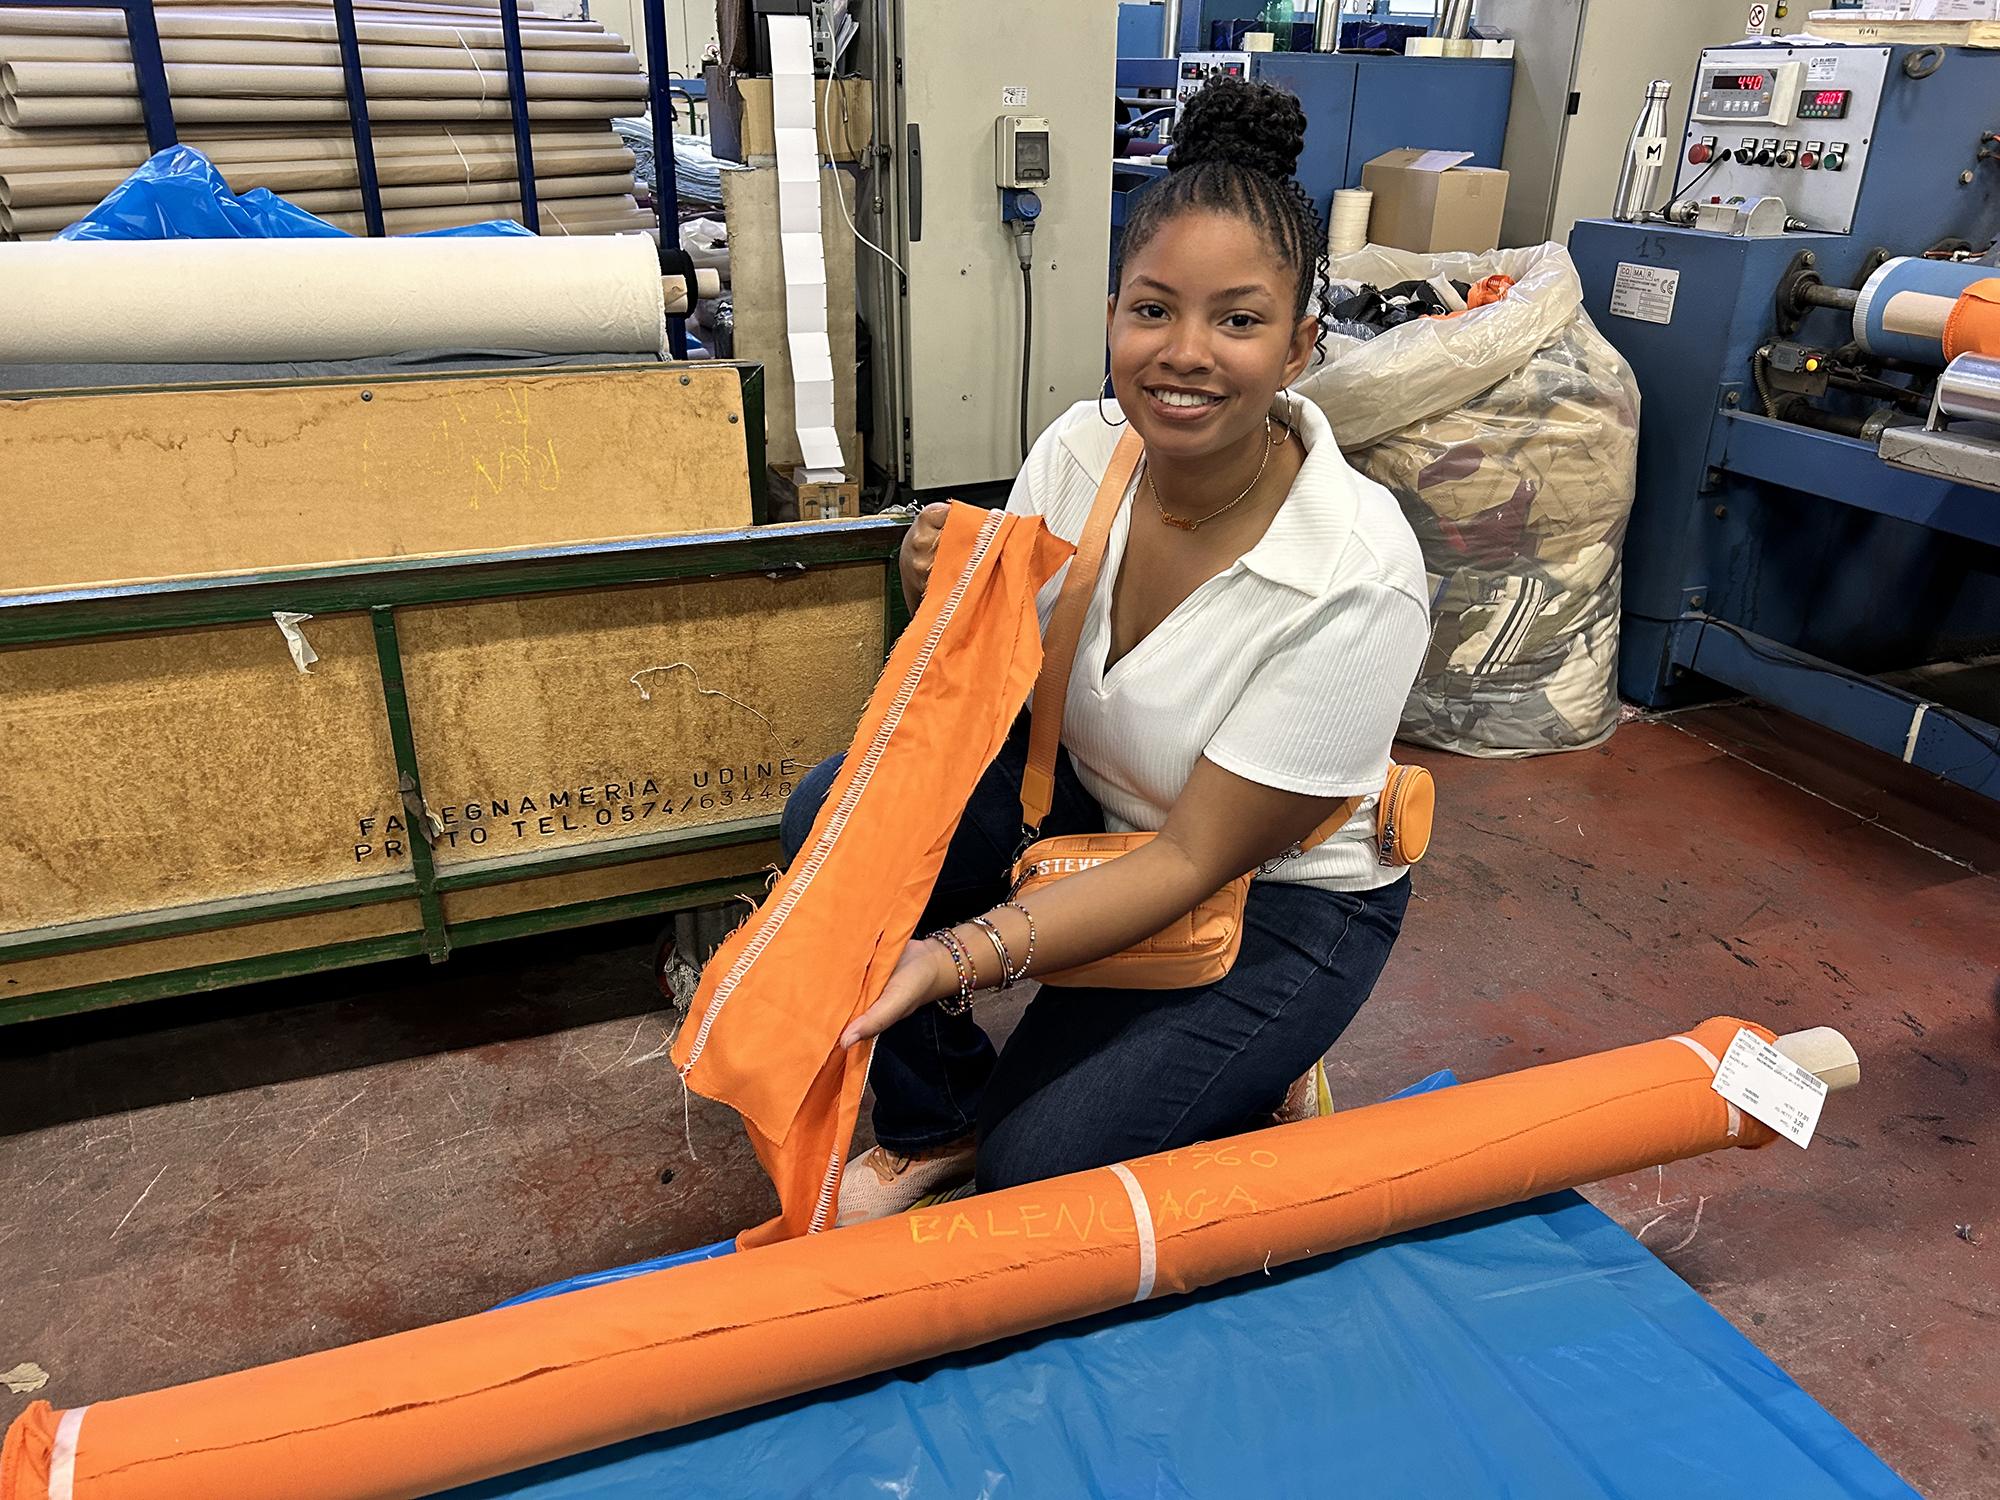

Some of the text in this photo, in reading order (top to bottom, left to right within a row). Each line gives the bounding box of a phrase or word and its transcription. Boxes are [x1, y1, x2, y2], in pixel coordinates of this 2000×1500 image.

[1646, 143, 1662, 161] M
[360, 758, 796, 836] FAEGNAMERIA UDINE
[354, 827, 487, 863] PRTO
[908, 1185, 1258, 1243] BALENCAGA
